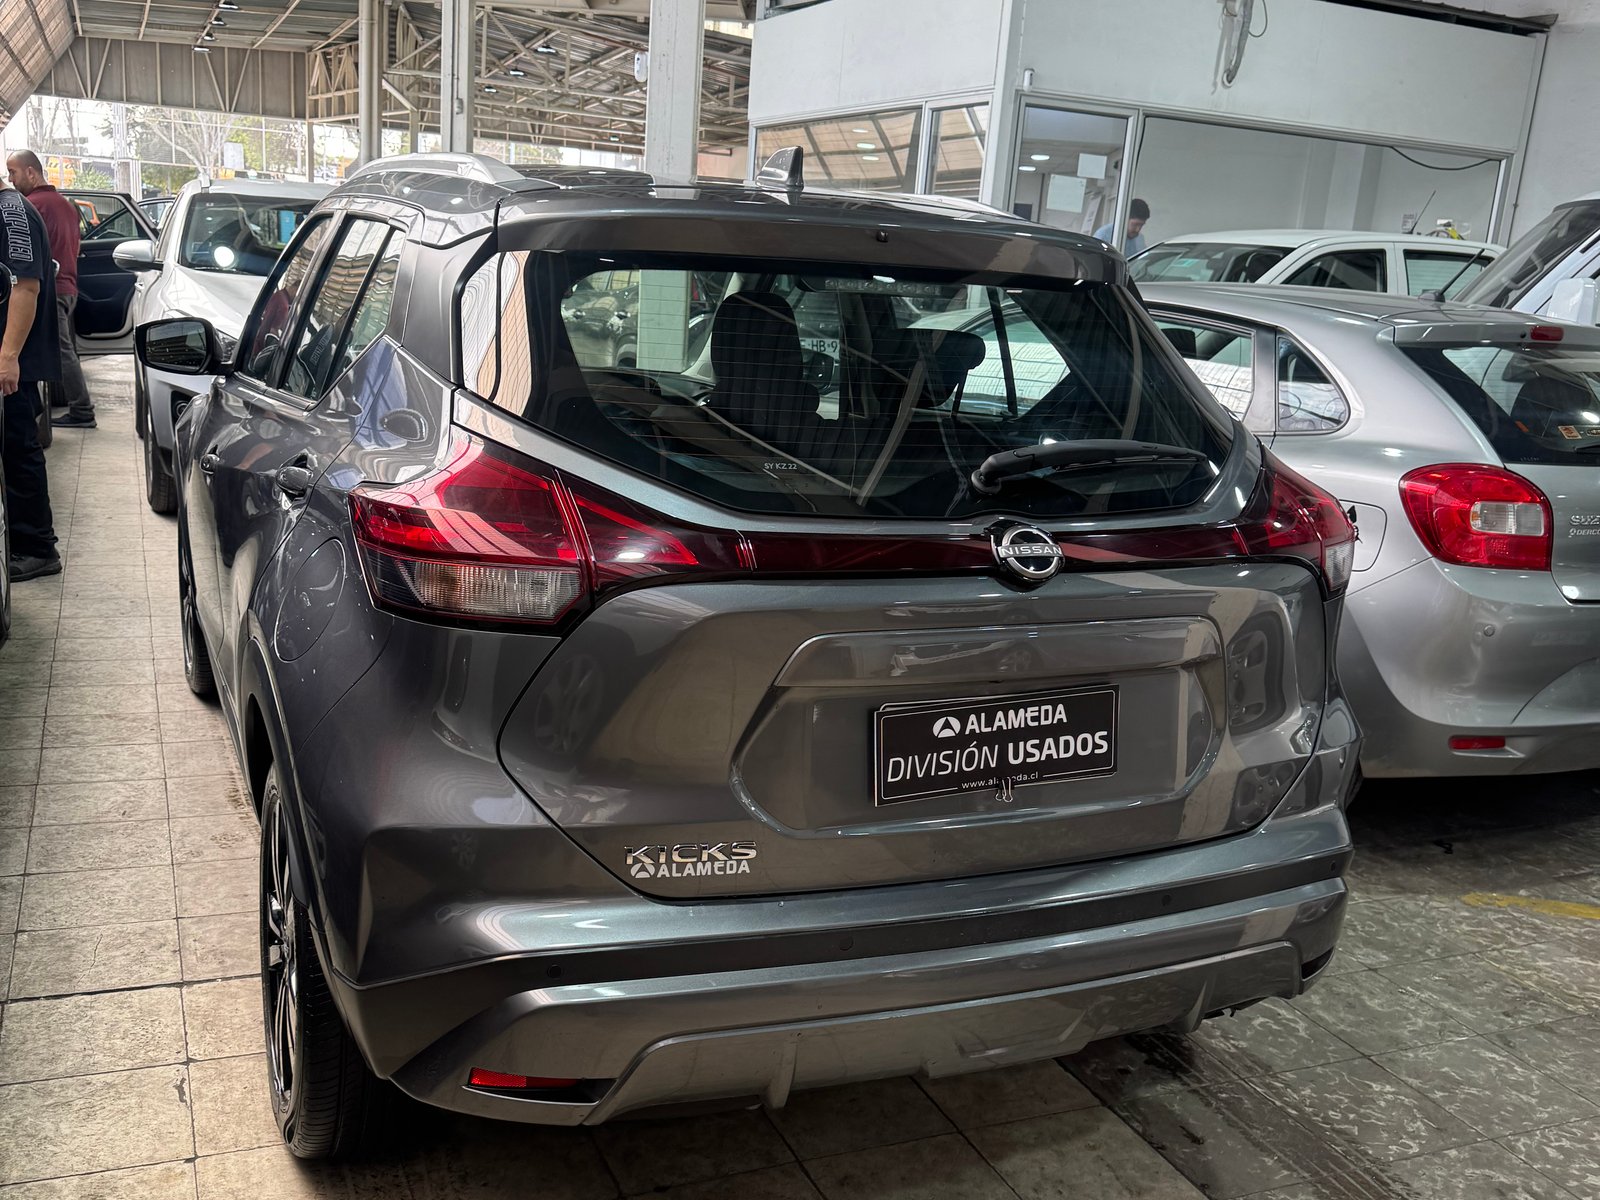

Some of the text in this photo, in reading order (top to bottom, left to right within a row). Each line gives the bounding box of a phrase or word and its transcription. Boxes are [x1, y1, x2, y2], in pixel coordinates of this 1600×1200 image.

[1001, 546, 1062, 555] NISSAN
[964, 703, 1068, 735] ALAMEDA
[887, 731, 1109, 783] DIVISIÓN USADOS
[624, 841, 757, 865] KICKS
[656, 860, 751, 878] ALAMEDA
